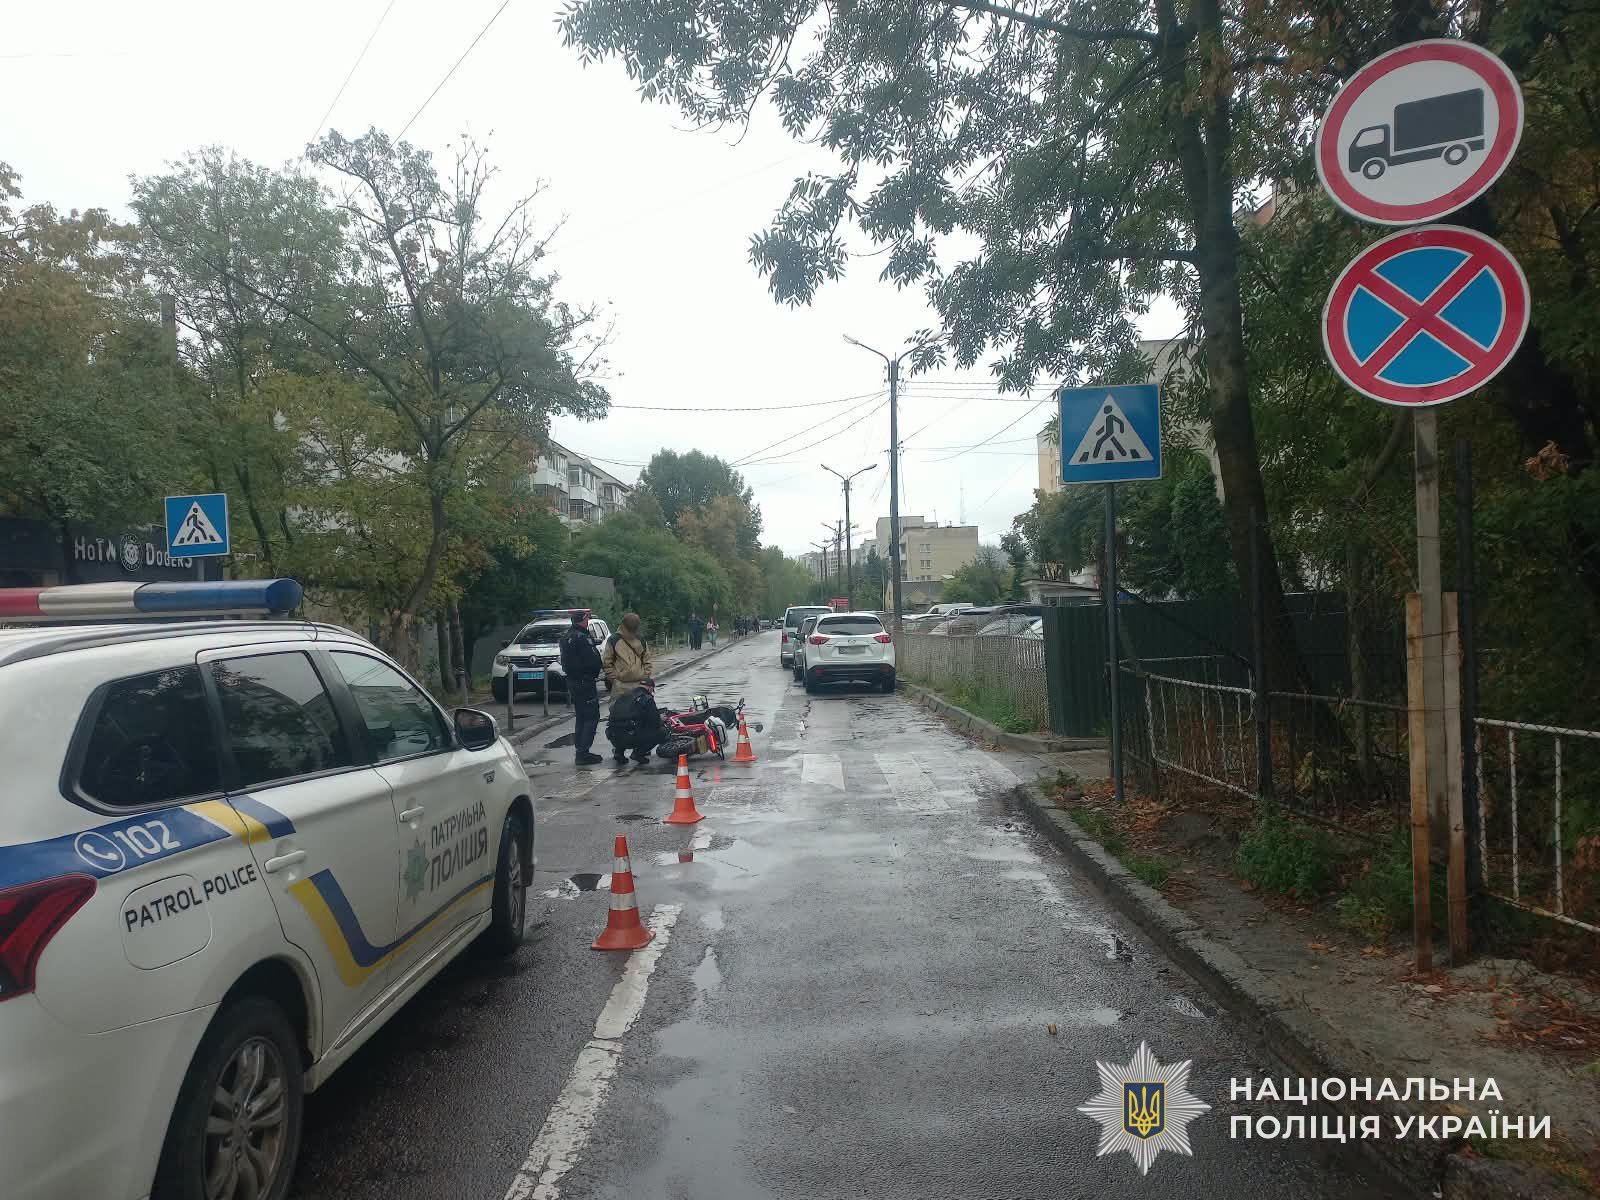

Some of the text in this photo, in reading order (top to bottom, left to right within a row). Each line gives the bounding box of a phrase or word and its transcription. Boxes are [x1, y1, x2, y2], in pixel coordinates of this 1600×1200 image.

[112, 820, 181, 859] 102
[430, 800, 487, 850] ПАТРУЛЬНА
[429, 826, 489, 893] ПОЛІЦІЯ
[125, 863, 257, 933] PATROL POLICE
